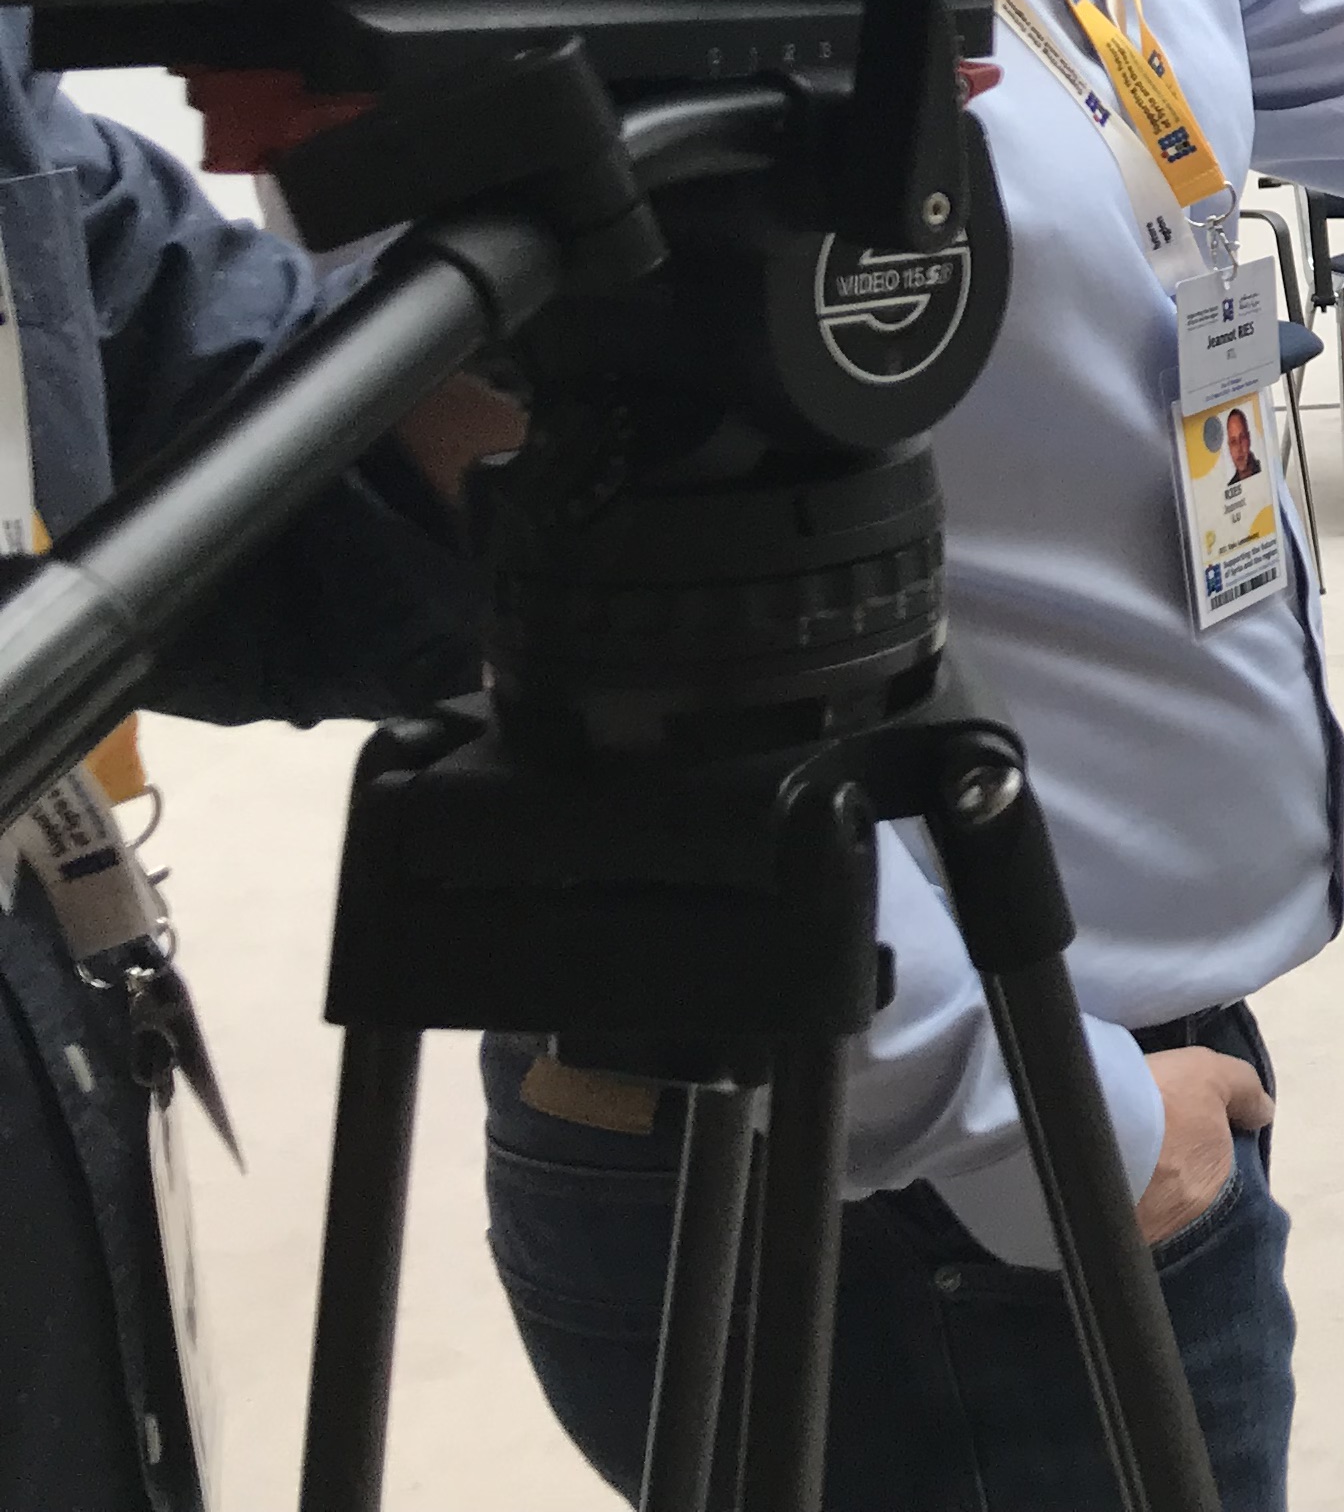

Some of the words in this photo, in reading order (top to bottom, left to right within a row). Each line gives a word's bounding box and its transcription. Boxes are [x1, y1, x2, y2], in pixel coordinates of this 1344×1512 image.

[1027, 32, 1041, 48] the
[1106, 42, 1124, 72] future
[1121, 72, 1131, 88] the
[1127, 65, 1137, 81] the
[1134, 80, 1150, 97] and
[1130, 87, 1162, 135] Supporting
[835, 269, 899, 296] VIDEO
